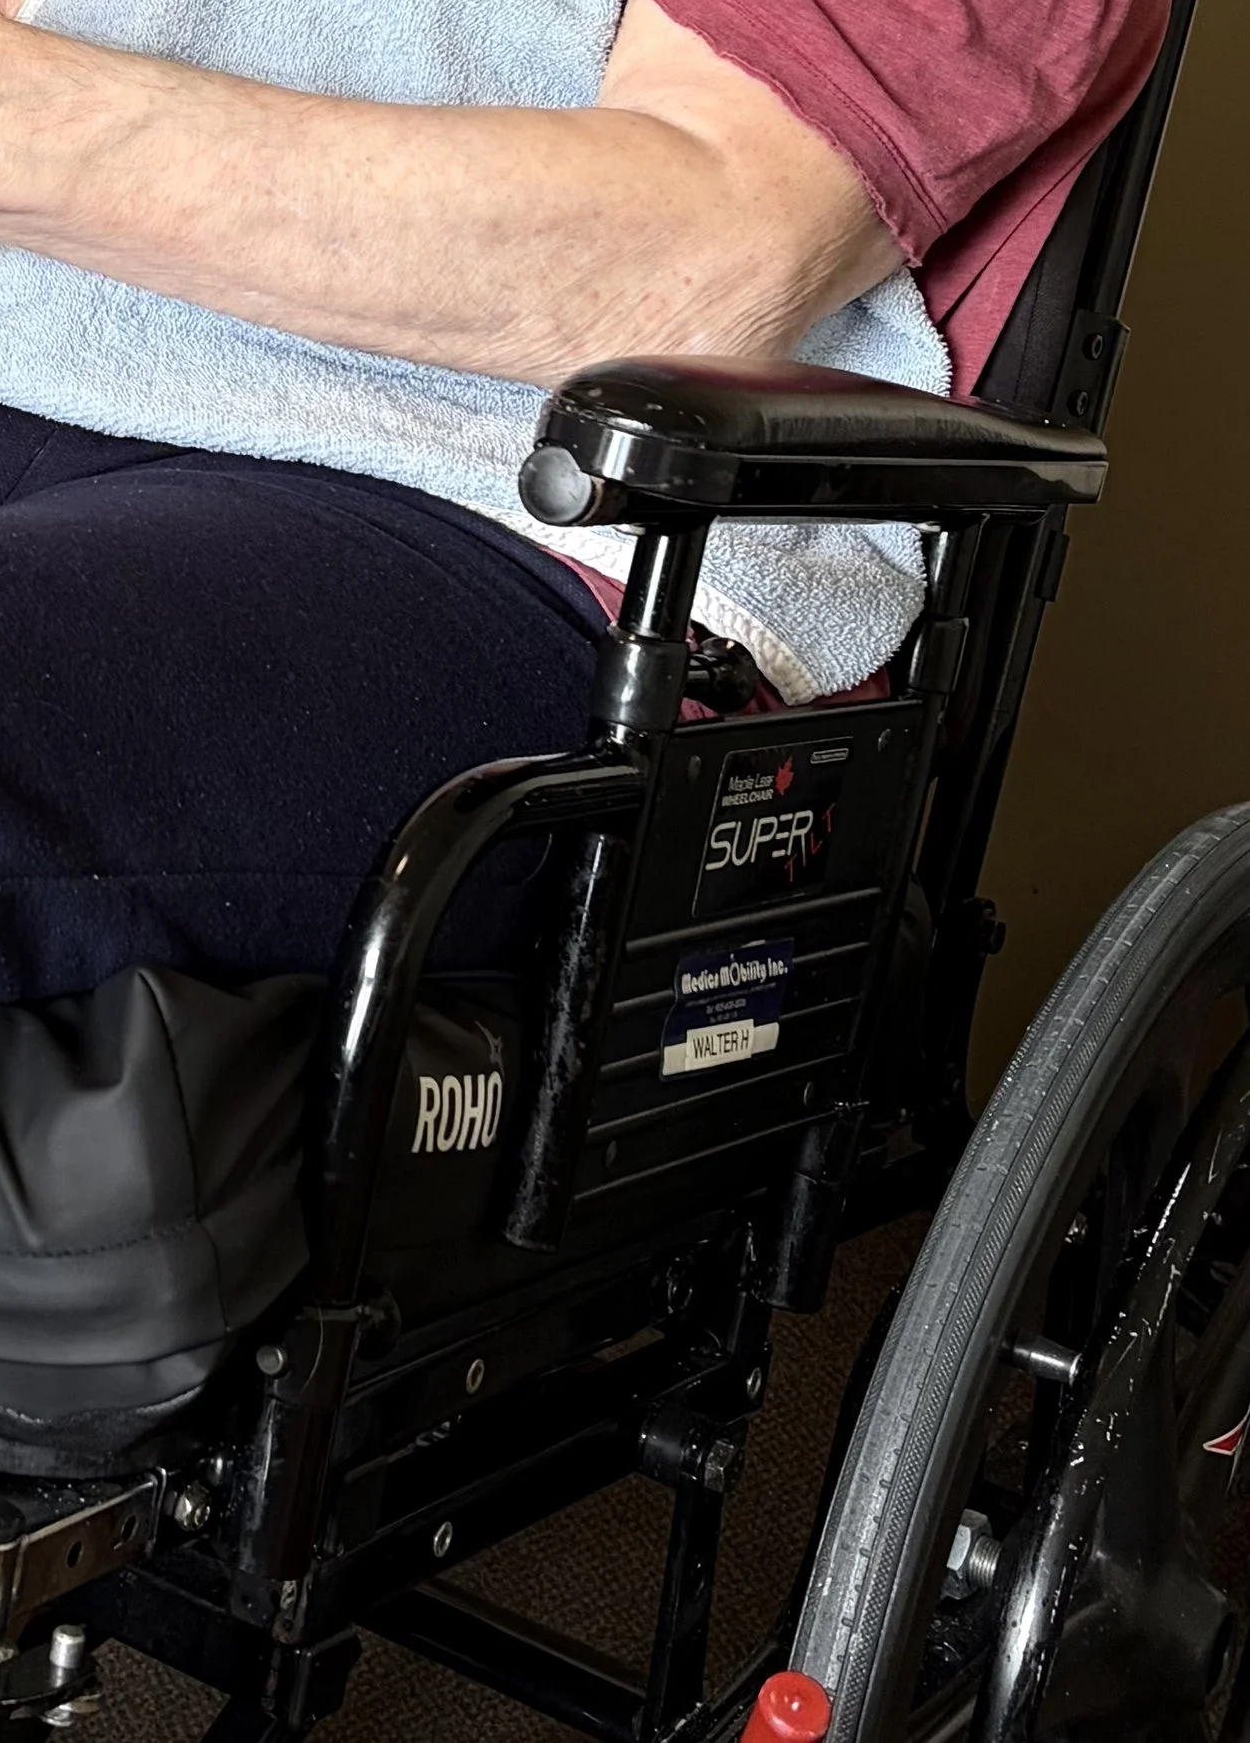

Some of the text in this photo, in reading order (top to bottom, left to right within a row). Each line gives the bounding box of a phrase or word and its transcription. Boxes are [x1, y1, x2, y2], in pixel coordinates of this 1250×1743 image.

[722, 789, 774, 807] WHEELCHAIR
[705, 810, 813, 871] SUPER
[693, 1029, 750, 1059] WALTER H
[411, 1071, 502, 1153] ROHO
